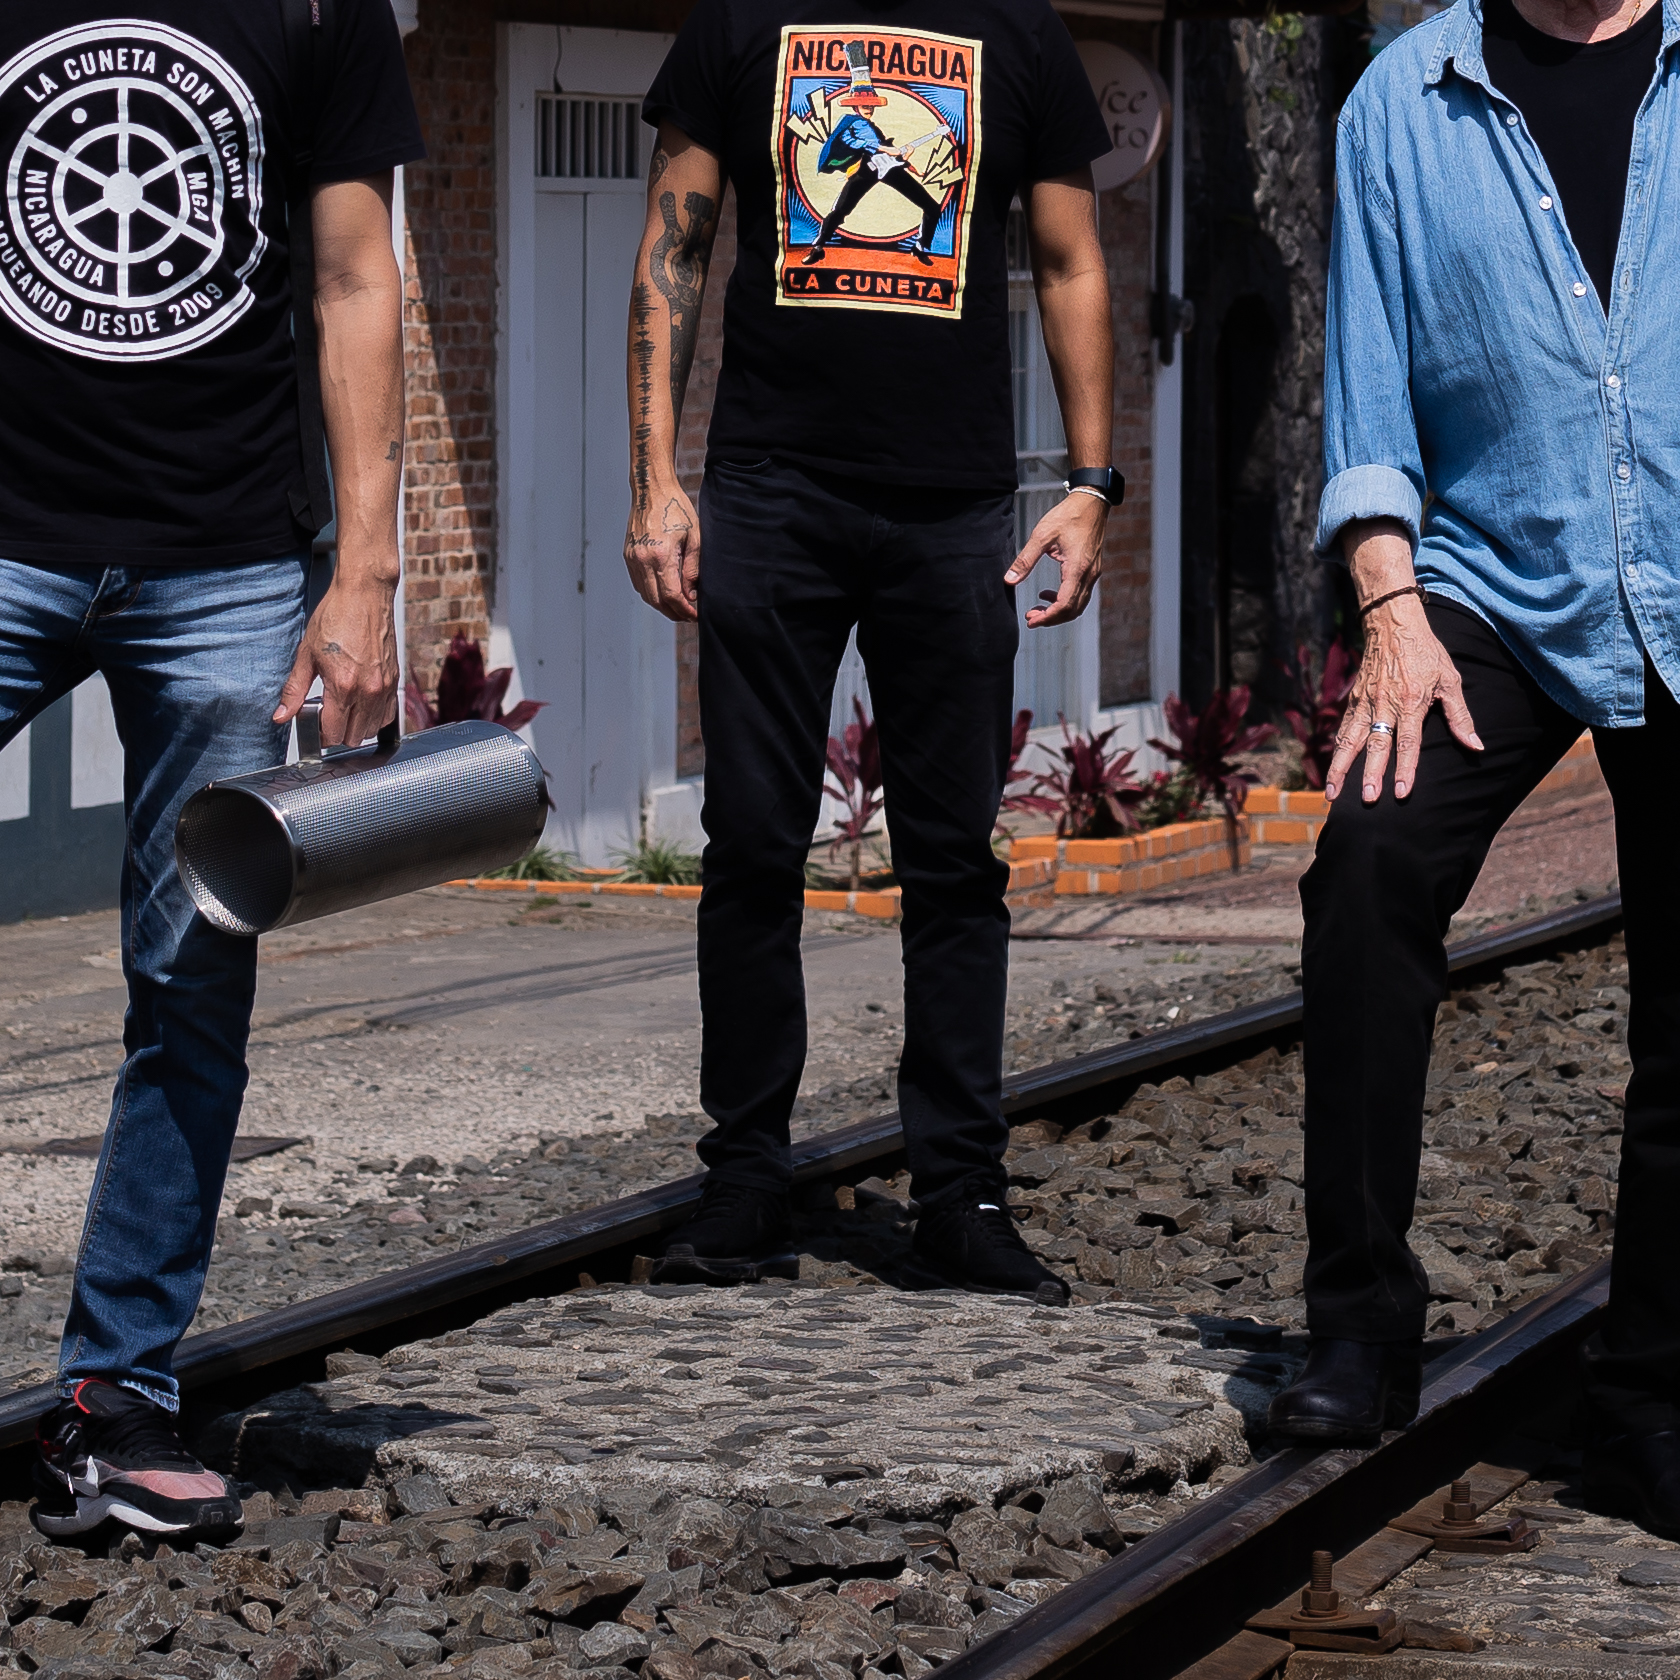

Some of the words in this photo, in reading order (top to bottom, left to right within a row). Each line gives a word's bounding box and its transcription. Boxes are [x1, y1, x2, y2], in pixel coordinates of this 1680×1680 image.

[791, 39, 969, 84] NICRAGUA
[23, 72, 59, 103] LA
[63, 47, 156, 81] CUNETA
[166, 62, 215, 106] SON
[208, 107, 245, 199] MACHIN
[186, 171, 210, 222] MGA
[24, 169, 104, 287] NICARAGUA
[80, 308, 161, 336] DESDE
[167, 282, 224, 327] 2009
[789, 272, 821, 291] LA
[835, 274, 944, 301] CUNETA
